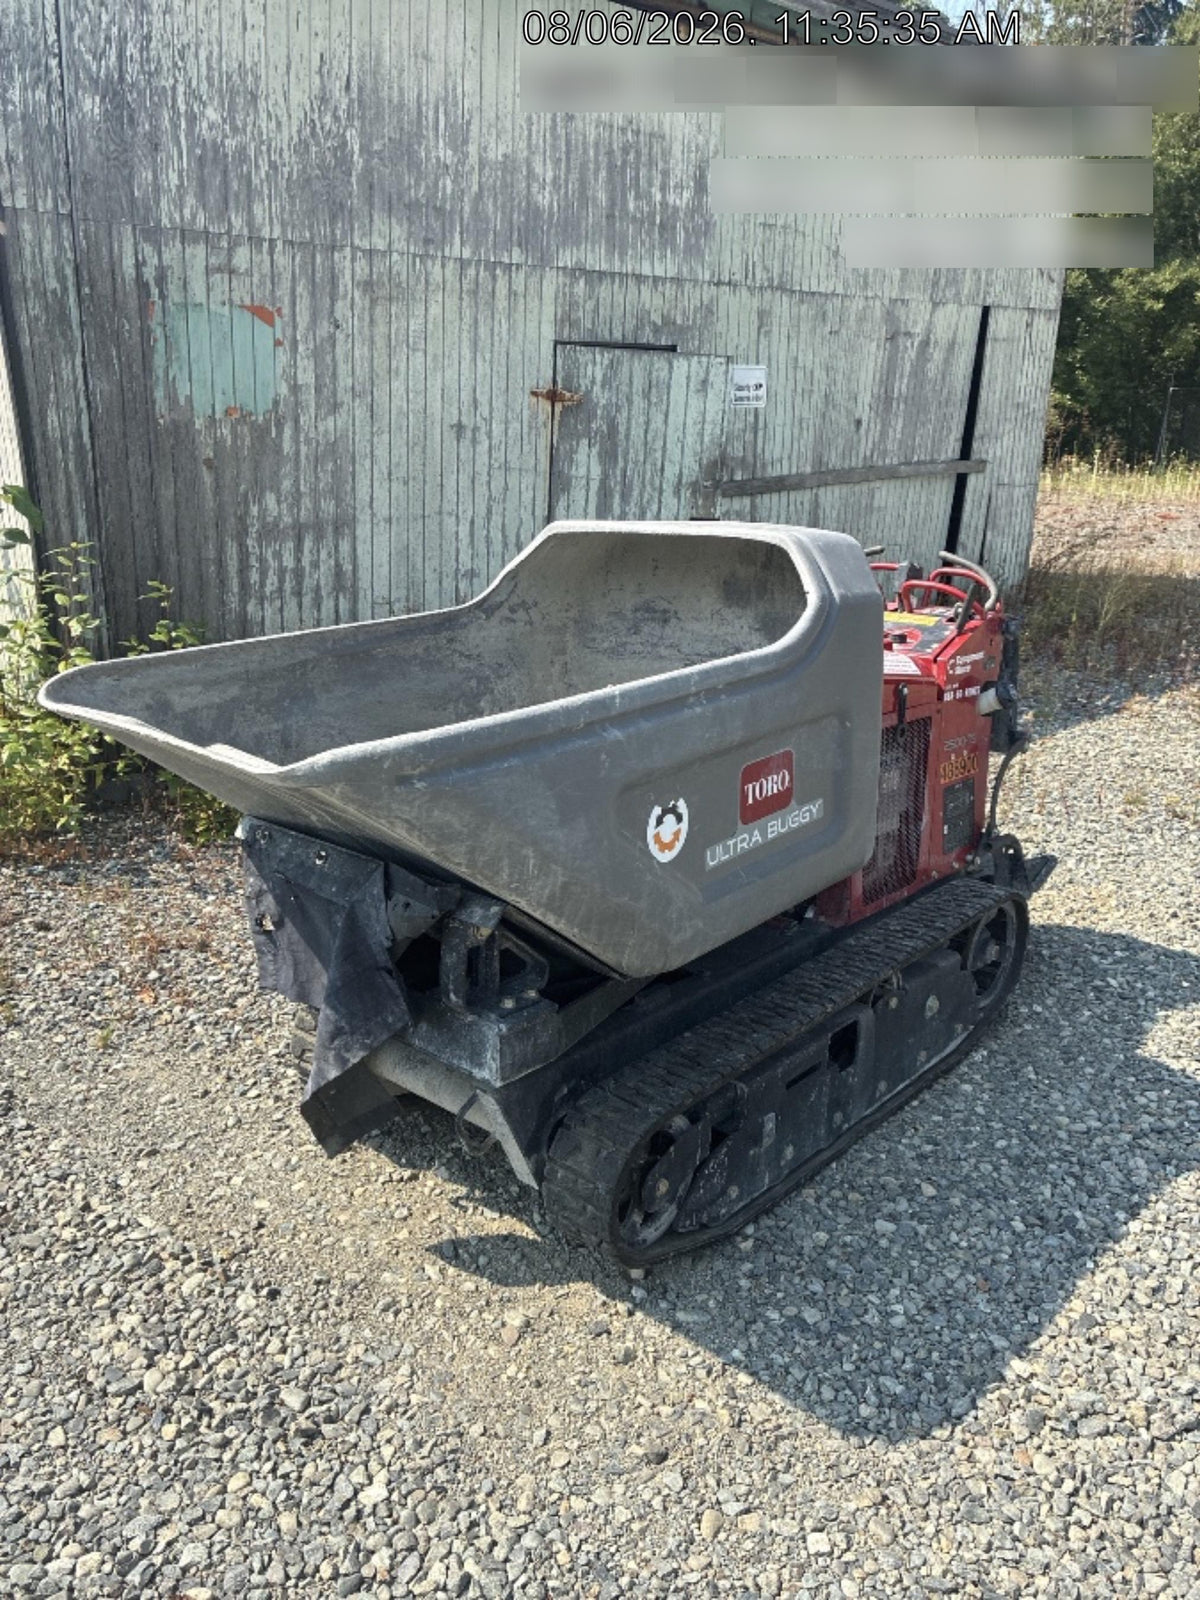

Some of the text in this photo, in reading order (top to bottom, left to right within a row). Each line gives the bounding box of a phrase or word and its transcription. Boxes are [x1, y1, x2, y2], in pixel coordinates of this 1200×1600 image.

[744, 768, 791, 806] TORO
[706, 799, 825, 866] ULTRA BUGGY
